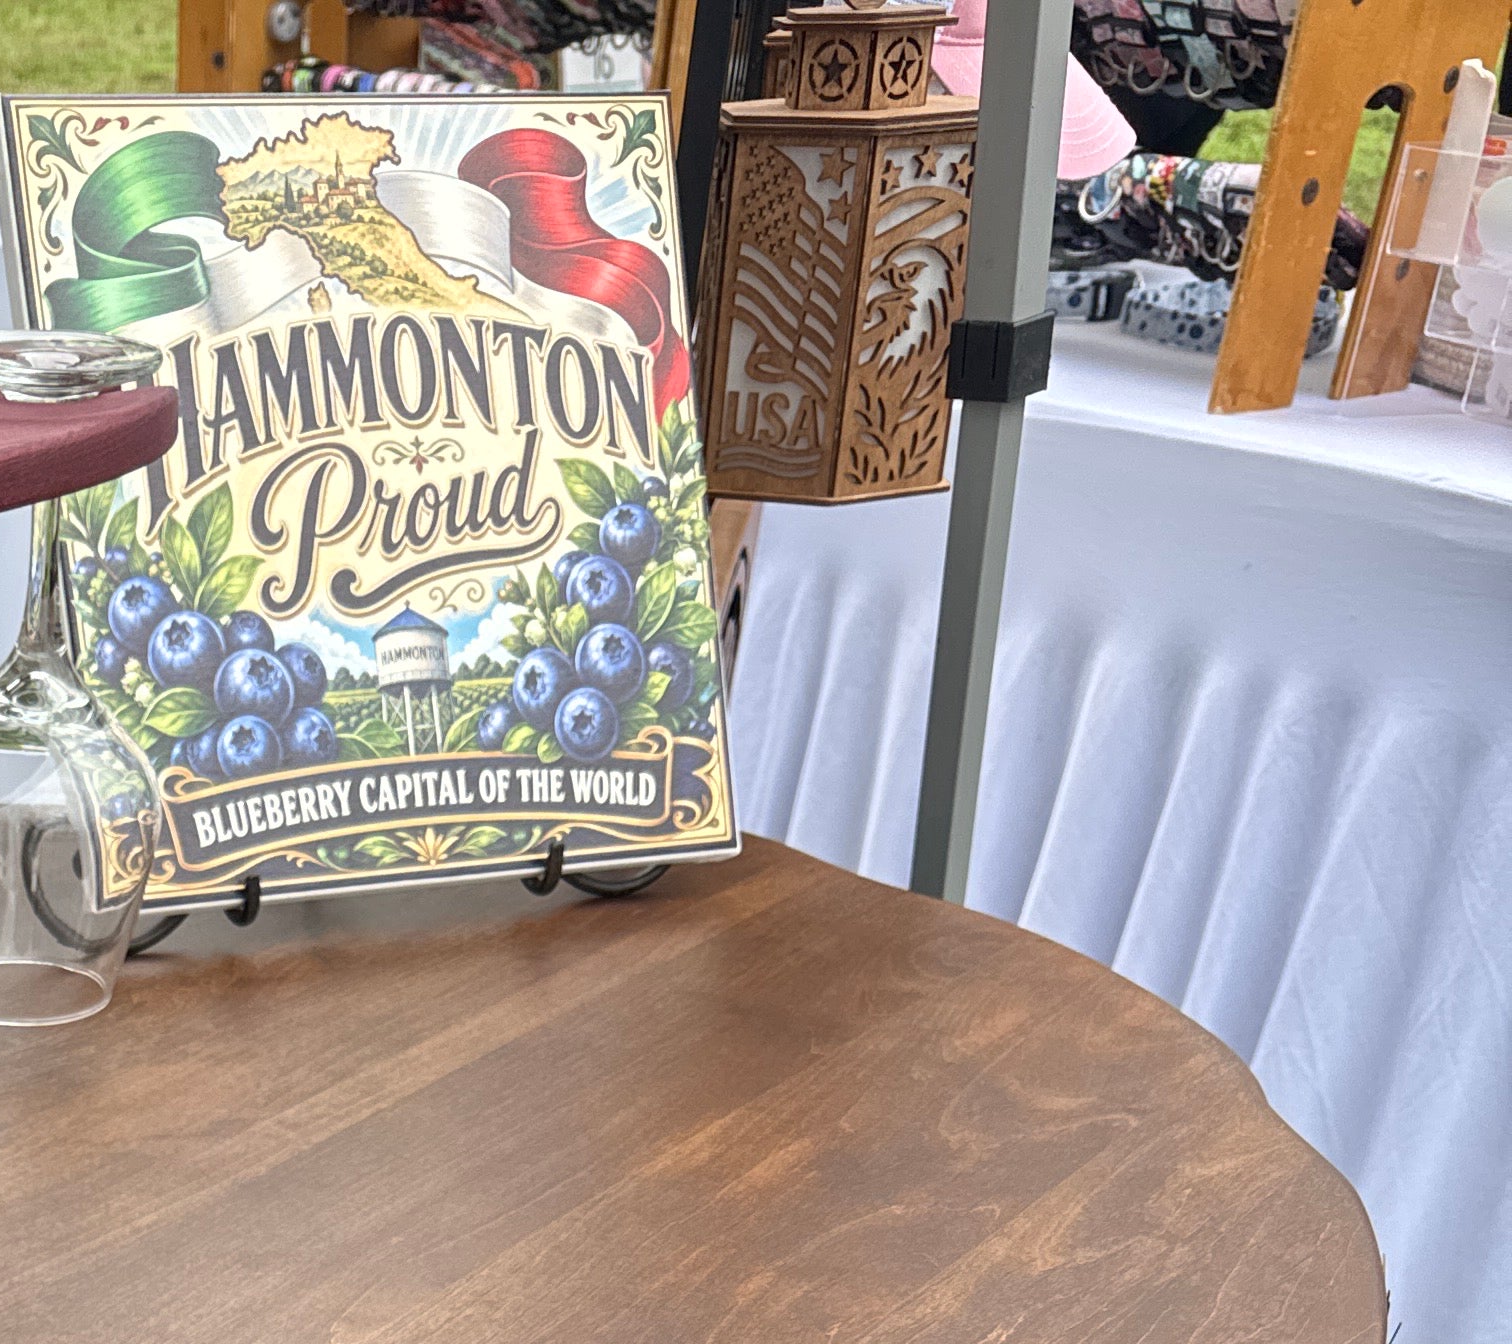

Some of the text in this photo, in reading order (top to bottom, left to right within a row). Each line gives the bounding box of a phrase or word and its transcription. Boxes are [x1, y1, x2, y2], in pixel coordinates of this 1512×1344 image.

[137, 314, 652, 537] HAMMONTON
[725, 391, 821, 448] USA
[252, 426, 562, 613] Proud
[381, 645, 445, 666] HAMMONTON
[192, 769, 657, 849] BLUEBERRY CAPITAL OF THE WORLD
